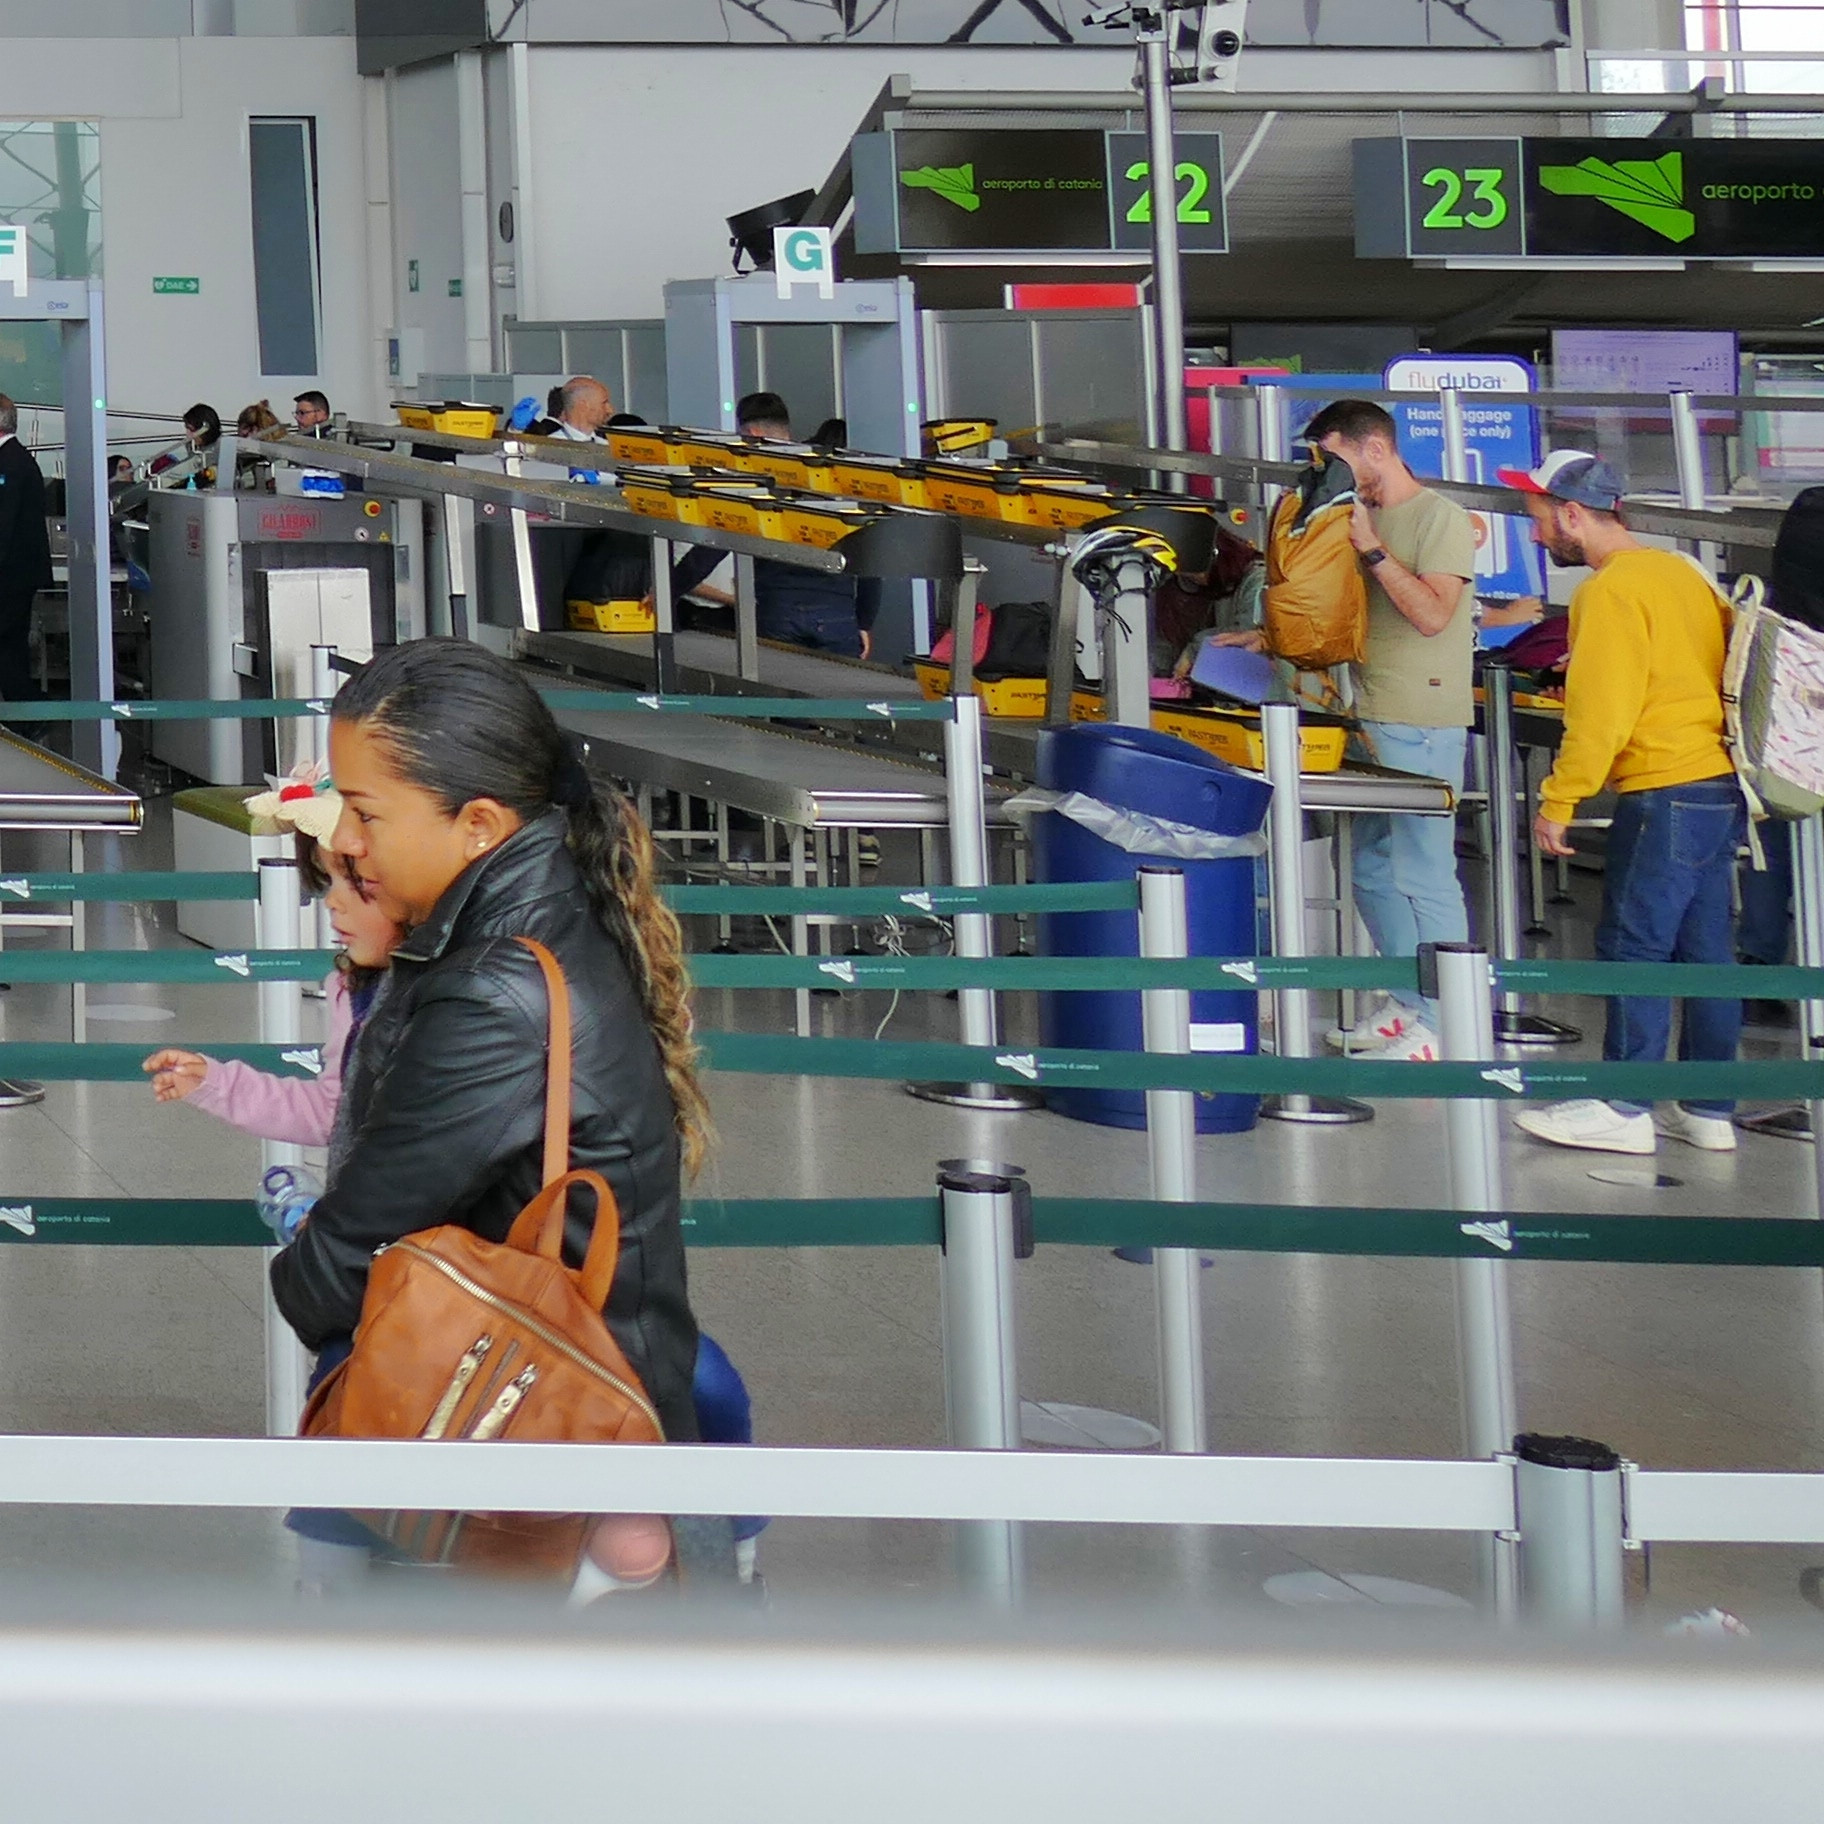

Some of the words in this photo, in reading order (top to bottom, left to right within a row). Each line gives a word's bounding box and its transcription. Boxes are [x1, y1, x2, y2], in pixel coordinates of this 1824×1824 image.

[982, 178, 1041, 192] aeroporto
[1043, 177, 1055, 190] di
[1058, 178, 1103, 190] catania
[1125, 161, 1211, 224] 22
[1702, 182, 1815, 205] aeroporto
[1422, 168, 1508, 229] 23
[784, 230, 823, 272] G
[1408, 371, 1503, 391] flydubai
[1410, 425, 1439, 439] (one
[1479, 425, 1512, 440] only)
